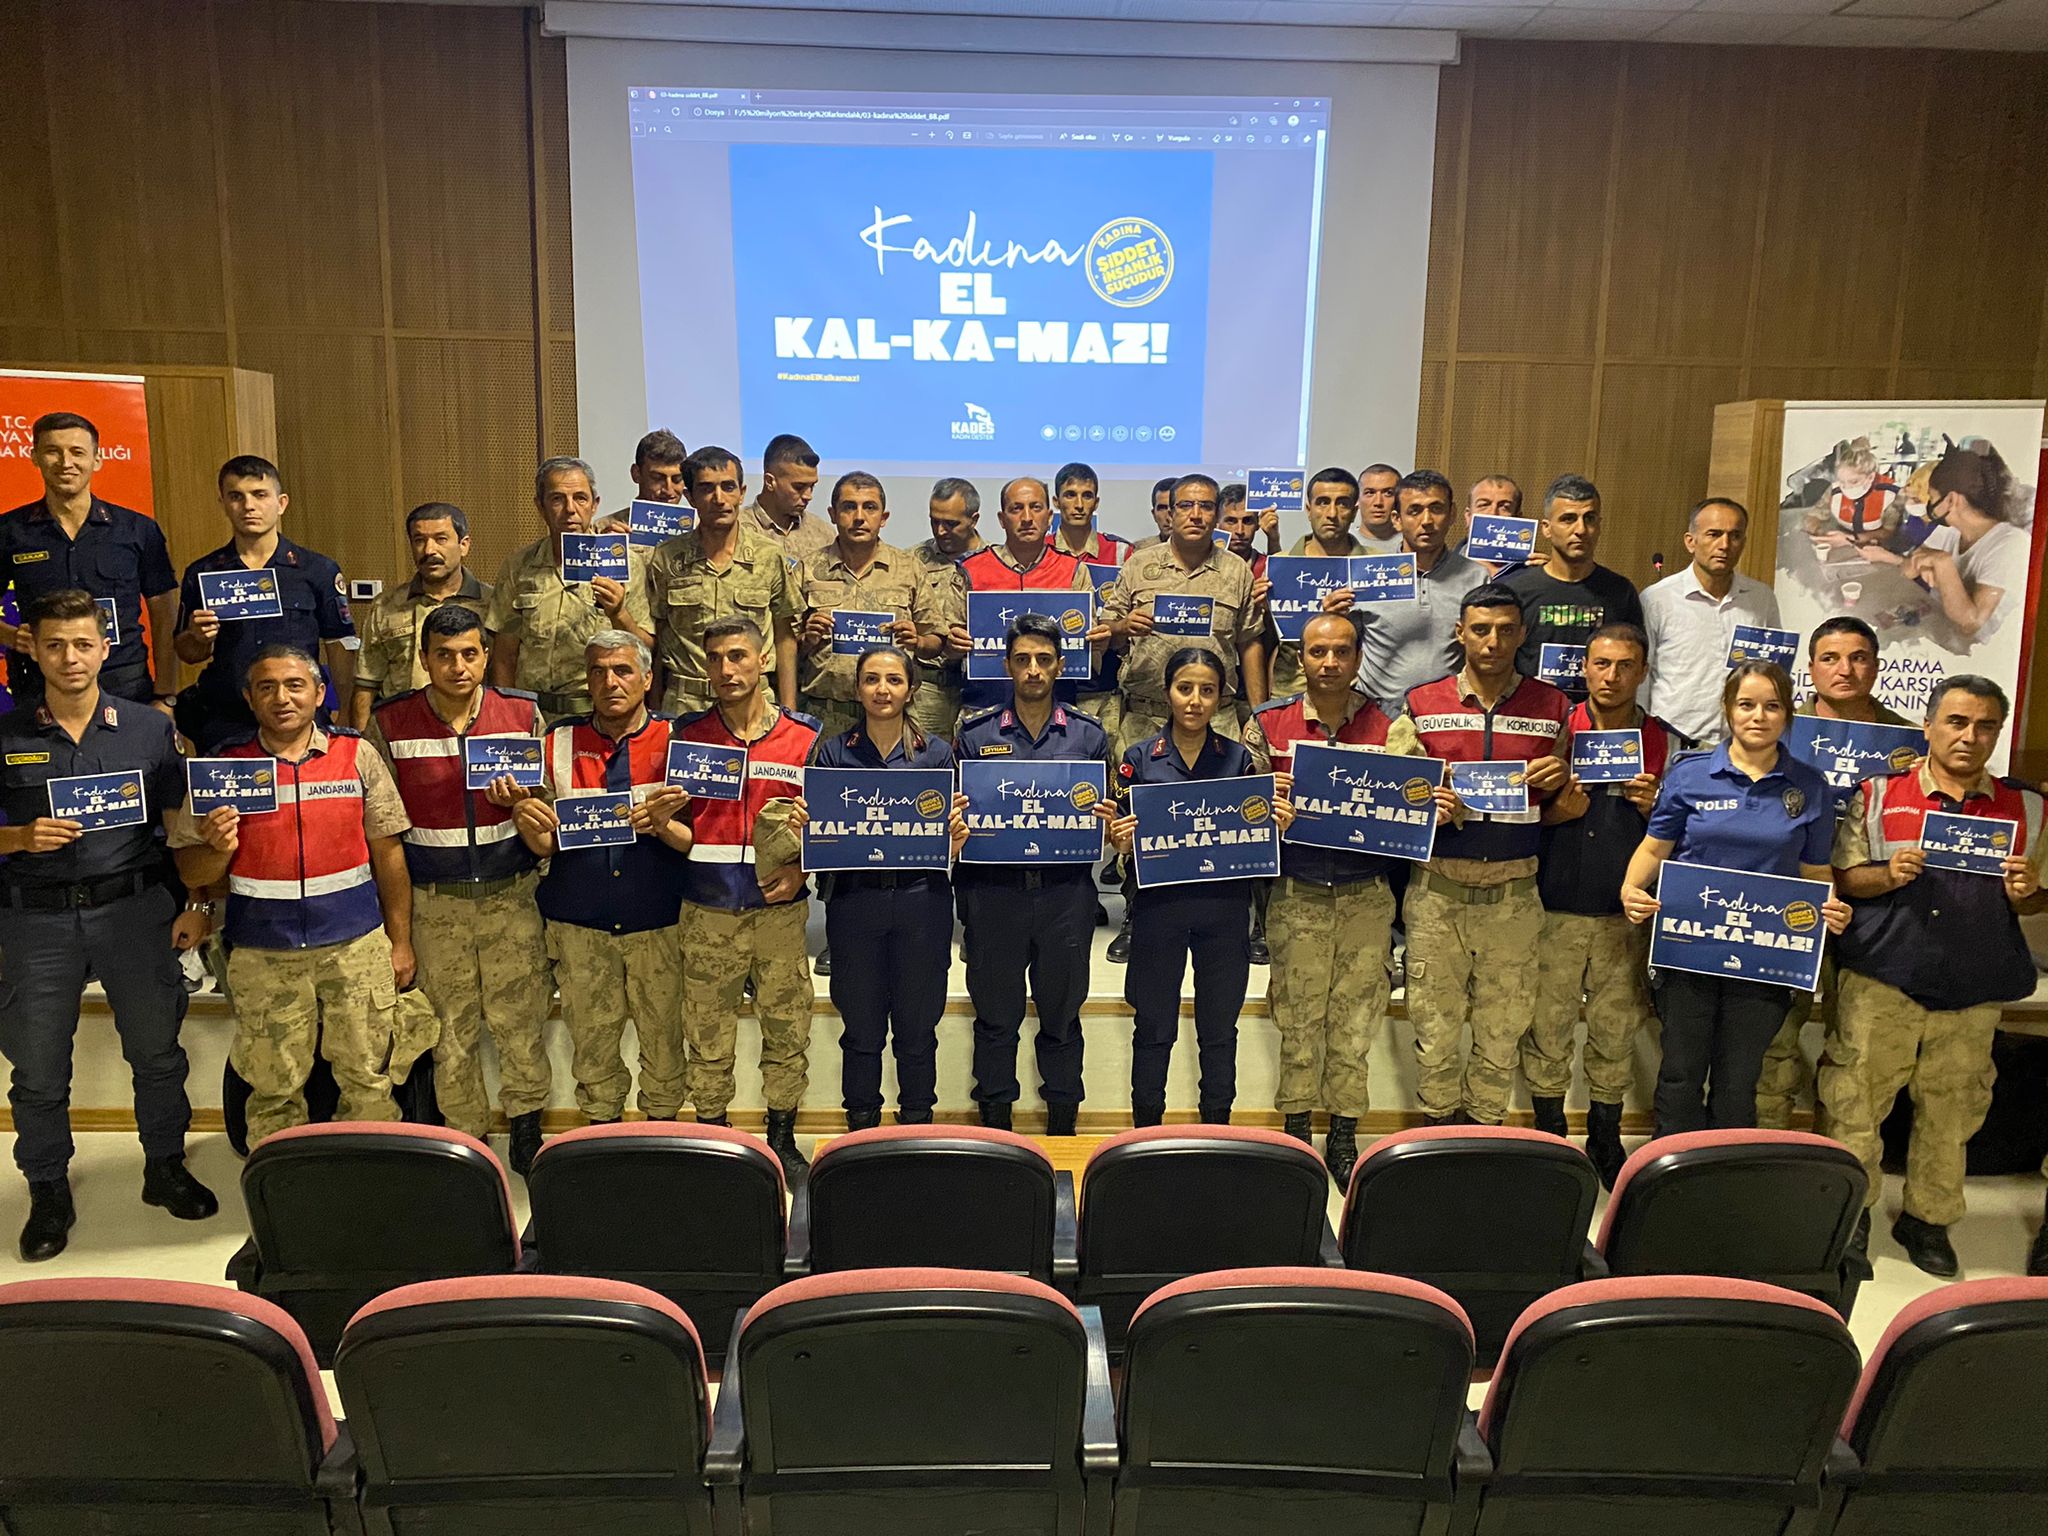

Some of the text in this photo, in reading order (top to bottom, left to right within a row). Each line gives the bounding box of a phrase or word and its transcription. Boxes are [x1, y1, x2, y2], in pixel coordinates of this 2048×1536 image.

[704, 109, 725, 117] Dosya
[859, 205, 1085, 275] Kadına
[1097, 224, 1142, 248] KADINA
[939, 272, 1007, 315] EL
[774, 316, 1170, 365] KAL-KA-MAZ!
[2, 416, 32, 429] T.C.
[951, 420, 995, 434] KADES
[1422, 718, 1559, 734] GÜVENLİK KORUCUSU
[1810, 735, 1889, 760] Kadına
[753, 766, 797, 778] JANDARMA
[1835, 757, 1860, 773] EL
[1328, 766, 1403, 791] Kadına
[307, 783, 356, 796] JANDARMA
[840, 786, 916, 808] Kadına
[997, 779, 1070, 801] Kadına
[1351, 788, 1374, 803] EL
[1022, 800, 1044, 813] EL
[1168, 798, 1241, 821] Kadına
[1295, 796, 1429, 825] KAL-KA-MAZ!
[1695, 799, 1738, 811] POLİS
[866, 807, 889, 820] EL
[809, 821, 944, 836] KAL-KA-MAZ!
[968, 814, 1097, 830] KAL-KA-MAZ!
[1194, 817, 1216, 832] EL
[1141, 828, 1270, 851] KAL-KA-MAZ!
[1699, 885, 1784, 915] Kadına
[1725, 911, 1752, 928] EL
[1662, 917, 1814, 952] KAL-KA-MAZ!
